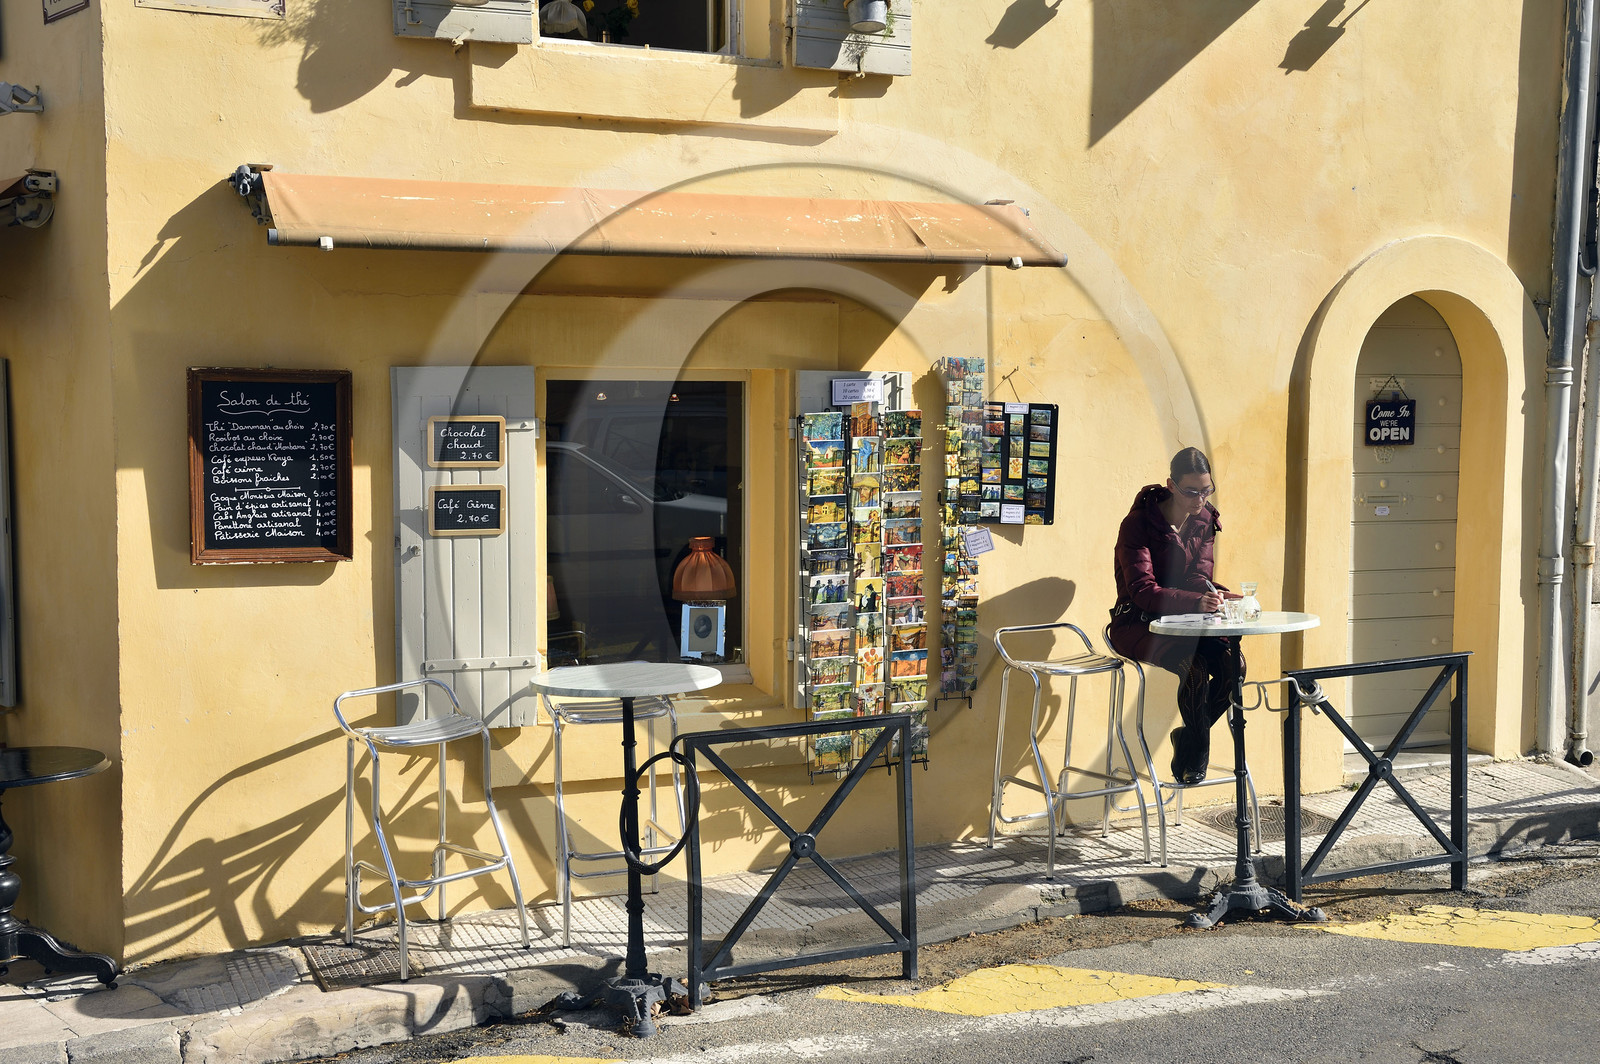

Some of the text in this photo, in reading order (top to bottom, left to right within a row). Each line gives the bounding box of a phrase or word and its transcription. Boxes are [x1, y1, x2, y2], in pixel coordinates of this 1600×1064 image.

[217, 390, 310, 407] Salon de thé
[1370, 404, 1410, 420] Come In
[206, 420, 226, 432] Thé
[285, 420, 304, 430] choix
[440, 425, 486, 438] Chocolat
[209, 432, 240, 442] Rooibos
[258, 432, 284, 441] choix
[1370, 426, 1410, 441] OPEN
[248, 442, 272, 451] chaud
[447, 438, 484, 449] chaud
[211, 454, 232, 468] Café
[268, 453, 294, 466] Kenya
[212, 466, 231, 480] Café
[212, 476, 252, 484] Boissons
[210, 493, 237, 506] Croque
[240, 490, 275, 500] Monsieur
[278, 490, 307, 498] Maison
[214, 502, 233, 512] Pain
[272, 498, 311, 508] artisanal
[438, 498, 496, 514] Café Crème
[236, 510, 268, 524] Anglais
[272, 506, 312, 518] artisanal
[256, 518, 302, 528] artisanal
[265, 528, 306, 538] Maison
